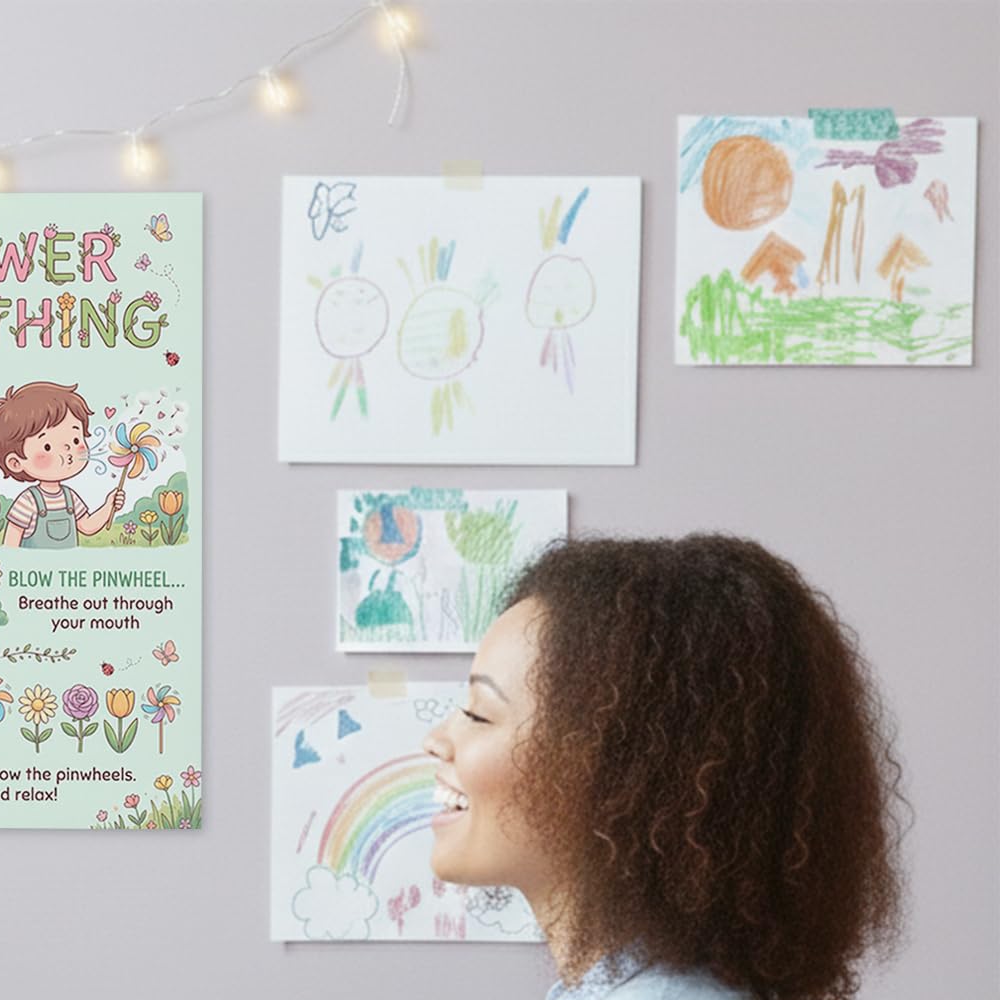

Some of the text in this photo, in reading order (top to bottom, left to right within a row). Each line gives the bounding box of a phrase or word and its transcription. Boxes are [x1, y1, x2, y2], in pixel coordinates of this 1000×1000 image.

[8, 570, 185, 588] BLOW THE PINWHEEL...
[18, 594, 174, 613] Breathe out through
[50, 614, 140, 633] your mouth
[25, 765, 52, 782] the
[55, 766, 137, 785] pinwheels.
[14, 786, 58, 802] relax!
